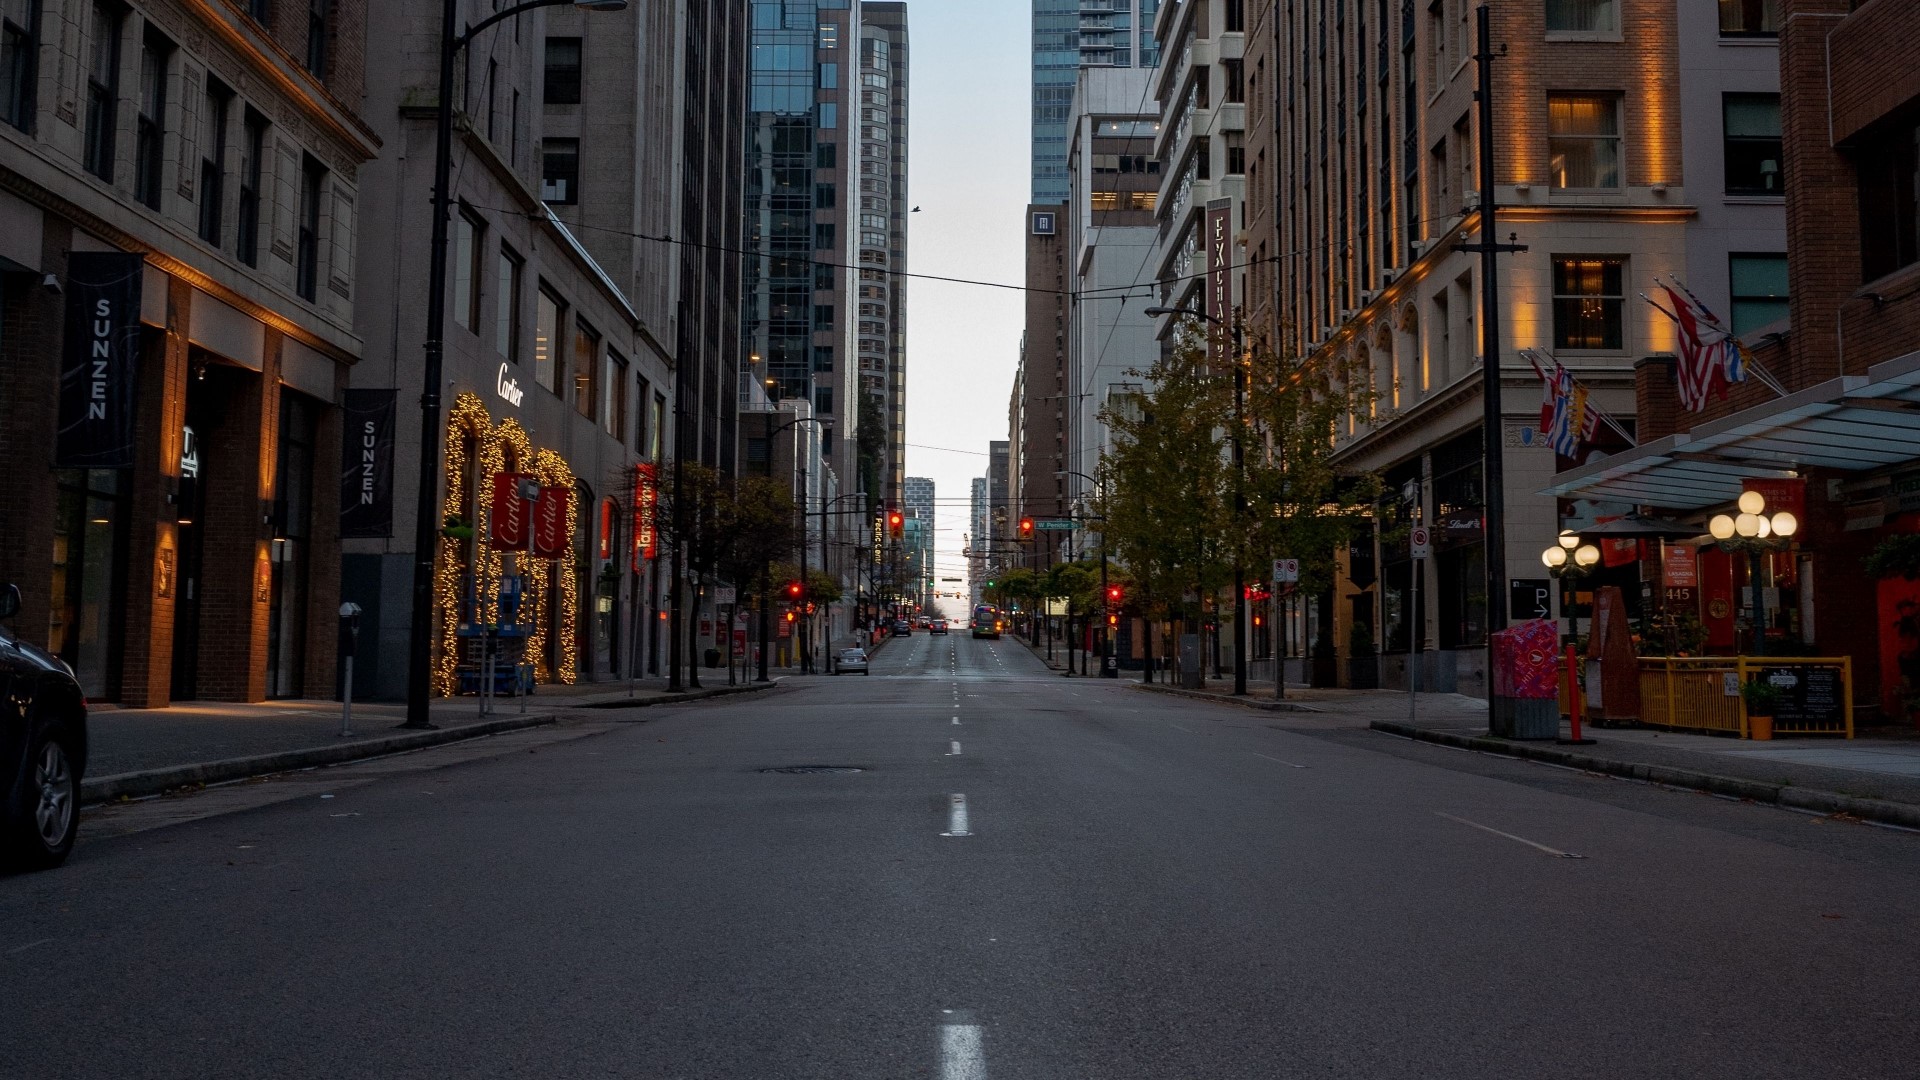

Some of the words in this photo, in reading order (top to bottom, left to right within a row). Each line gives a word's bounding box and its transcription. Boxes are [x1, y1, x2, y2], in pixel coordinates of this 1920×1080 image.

[88, 299, 111, 420] SUNZEN
[497, 362, 524, 408] Cartier
[361, 421, 376, 505] SUNZEN
[499, 478, 521, 545] Cartier
[536, 491, 557, 553] Cartier
[1447, 519, 1474, 529] Lindt
[874, 517, 883, 542] Pacific
[874, 543, 883, 565] Centr
[1535, 588, 1548, 604] P
[1665, 588, 1690, 600] 445
